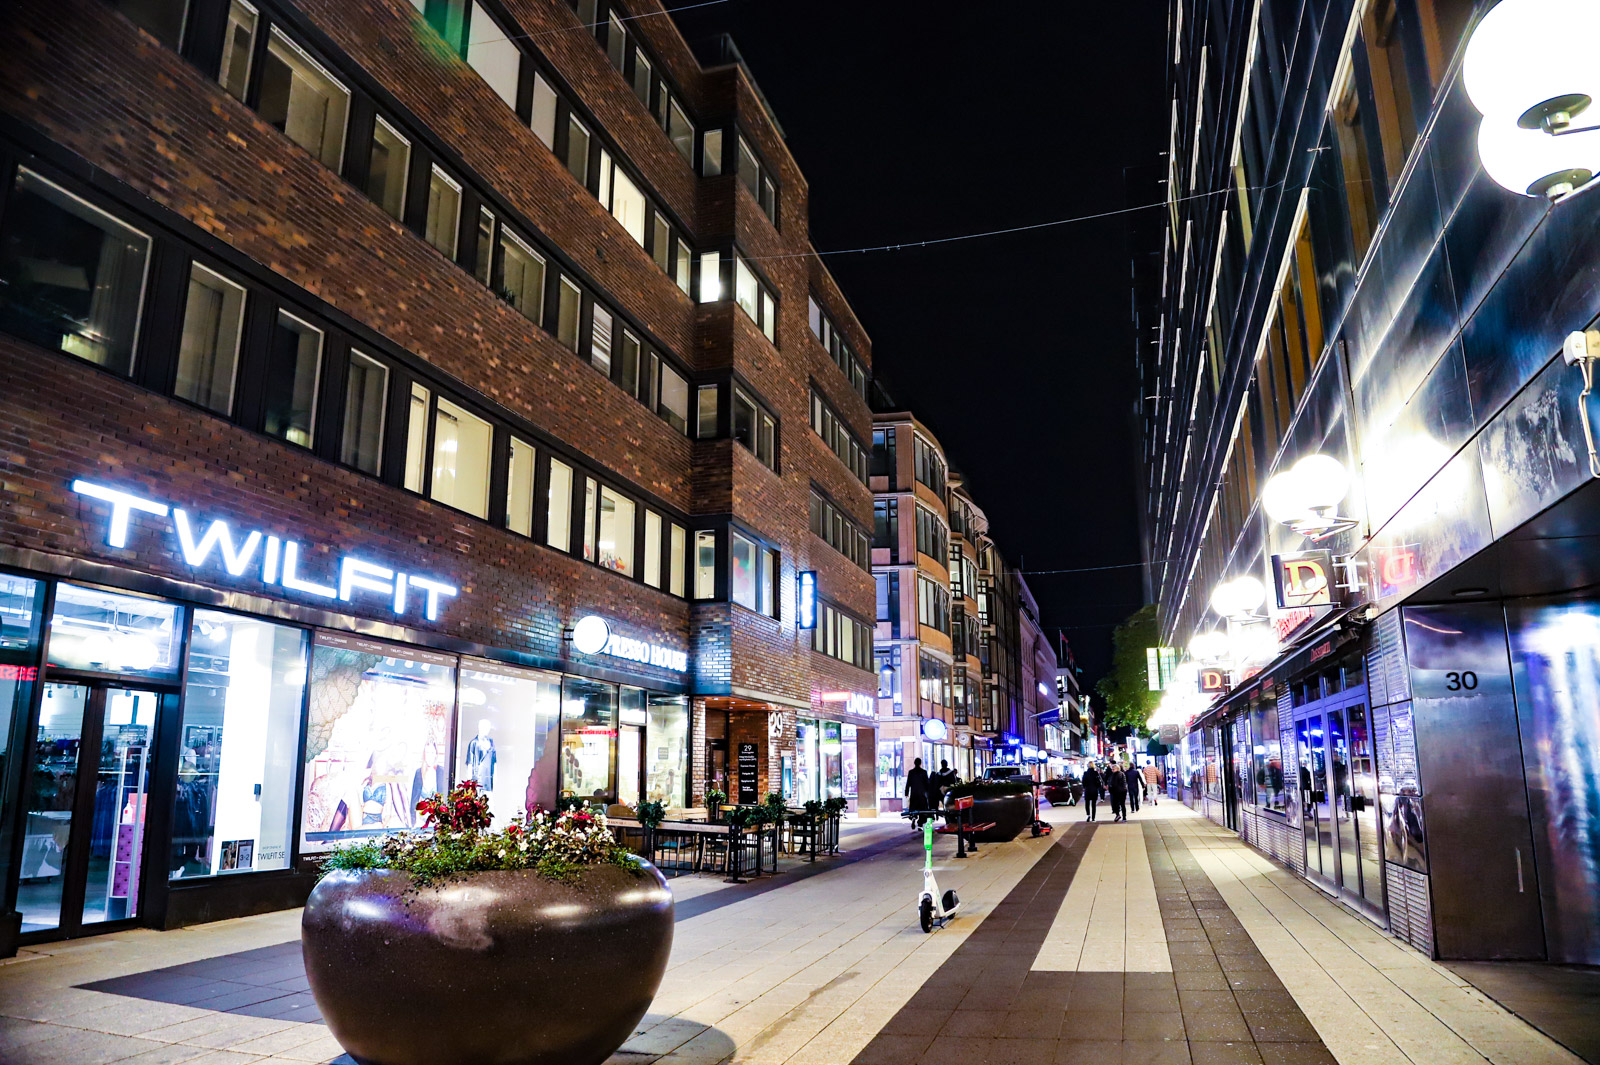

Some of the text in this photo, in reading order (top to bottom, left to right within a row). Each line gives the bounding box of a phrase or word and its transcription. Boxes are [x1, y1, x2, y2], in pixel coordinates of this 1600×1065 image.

[72, 478, 458, 622] TWILFIT
[1446, 670, 1478, 691] 30
[769, 711, 783, 738] 29
